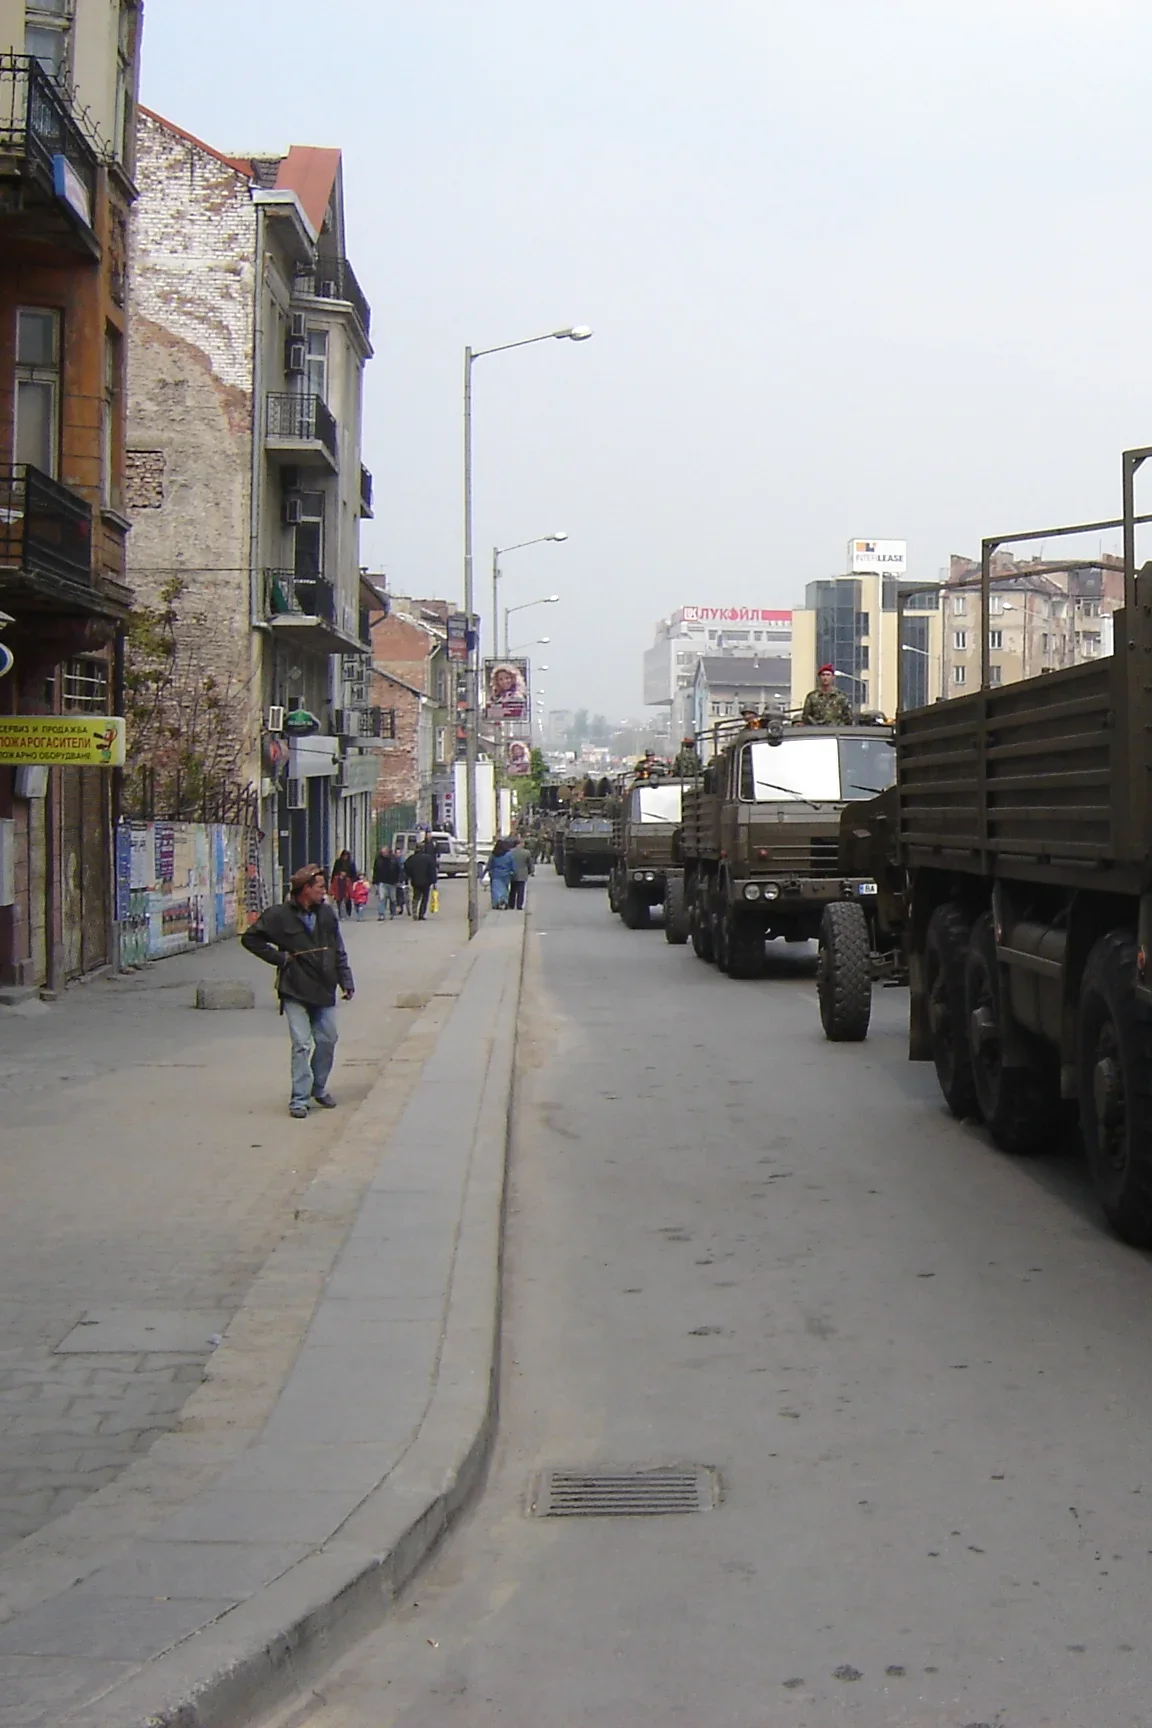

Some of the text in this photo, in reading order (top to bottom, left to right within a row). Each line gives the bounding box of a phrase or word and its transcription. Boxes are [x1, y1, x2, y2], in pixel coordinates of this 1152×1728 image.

[700, 606, 760, 621] ЛУКОЙЛ
[0, 725, 29, 734] СЕРВИЗ
[41, 726, 88, 734] ПРОДАЖБА
